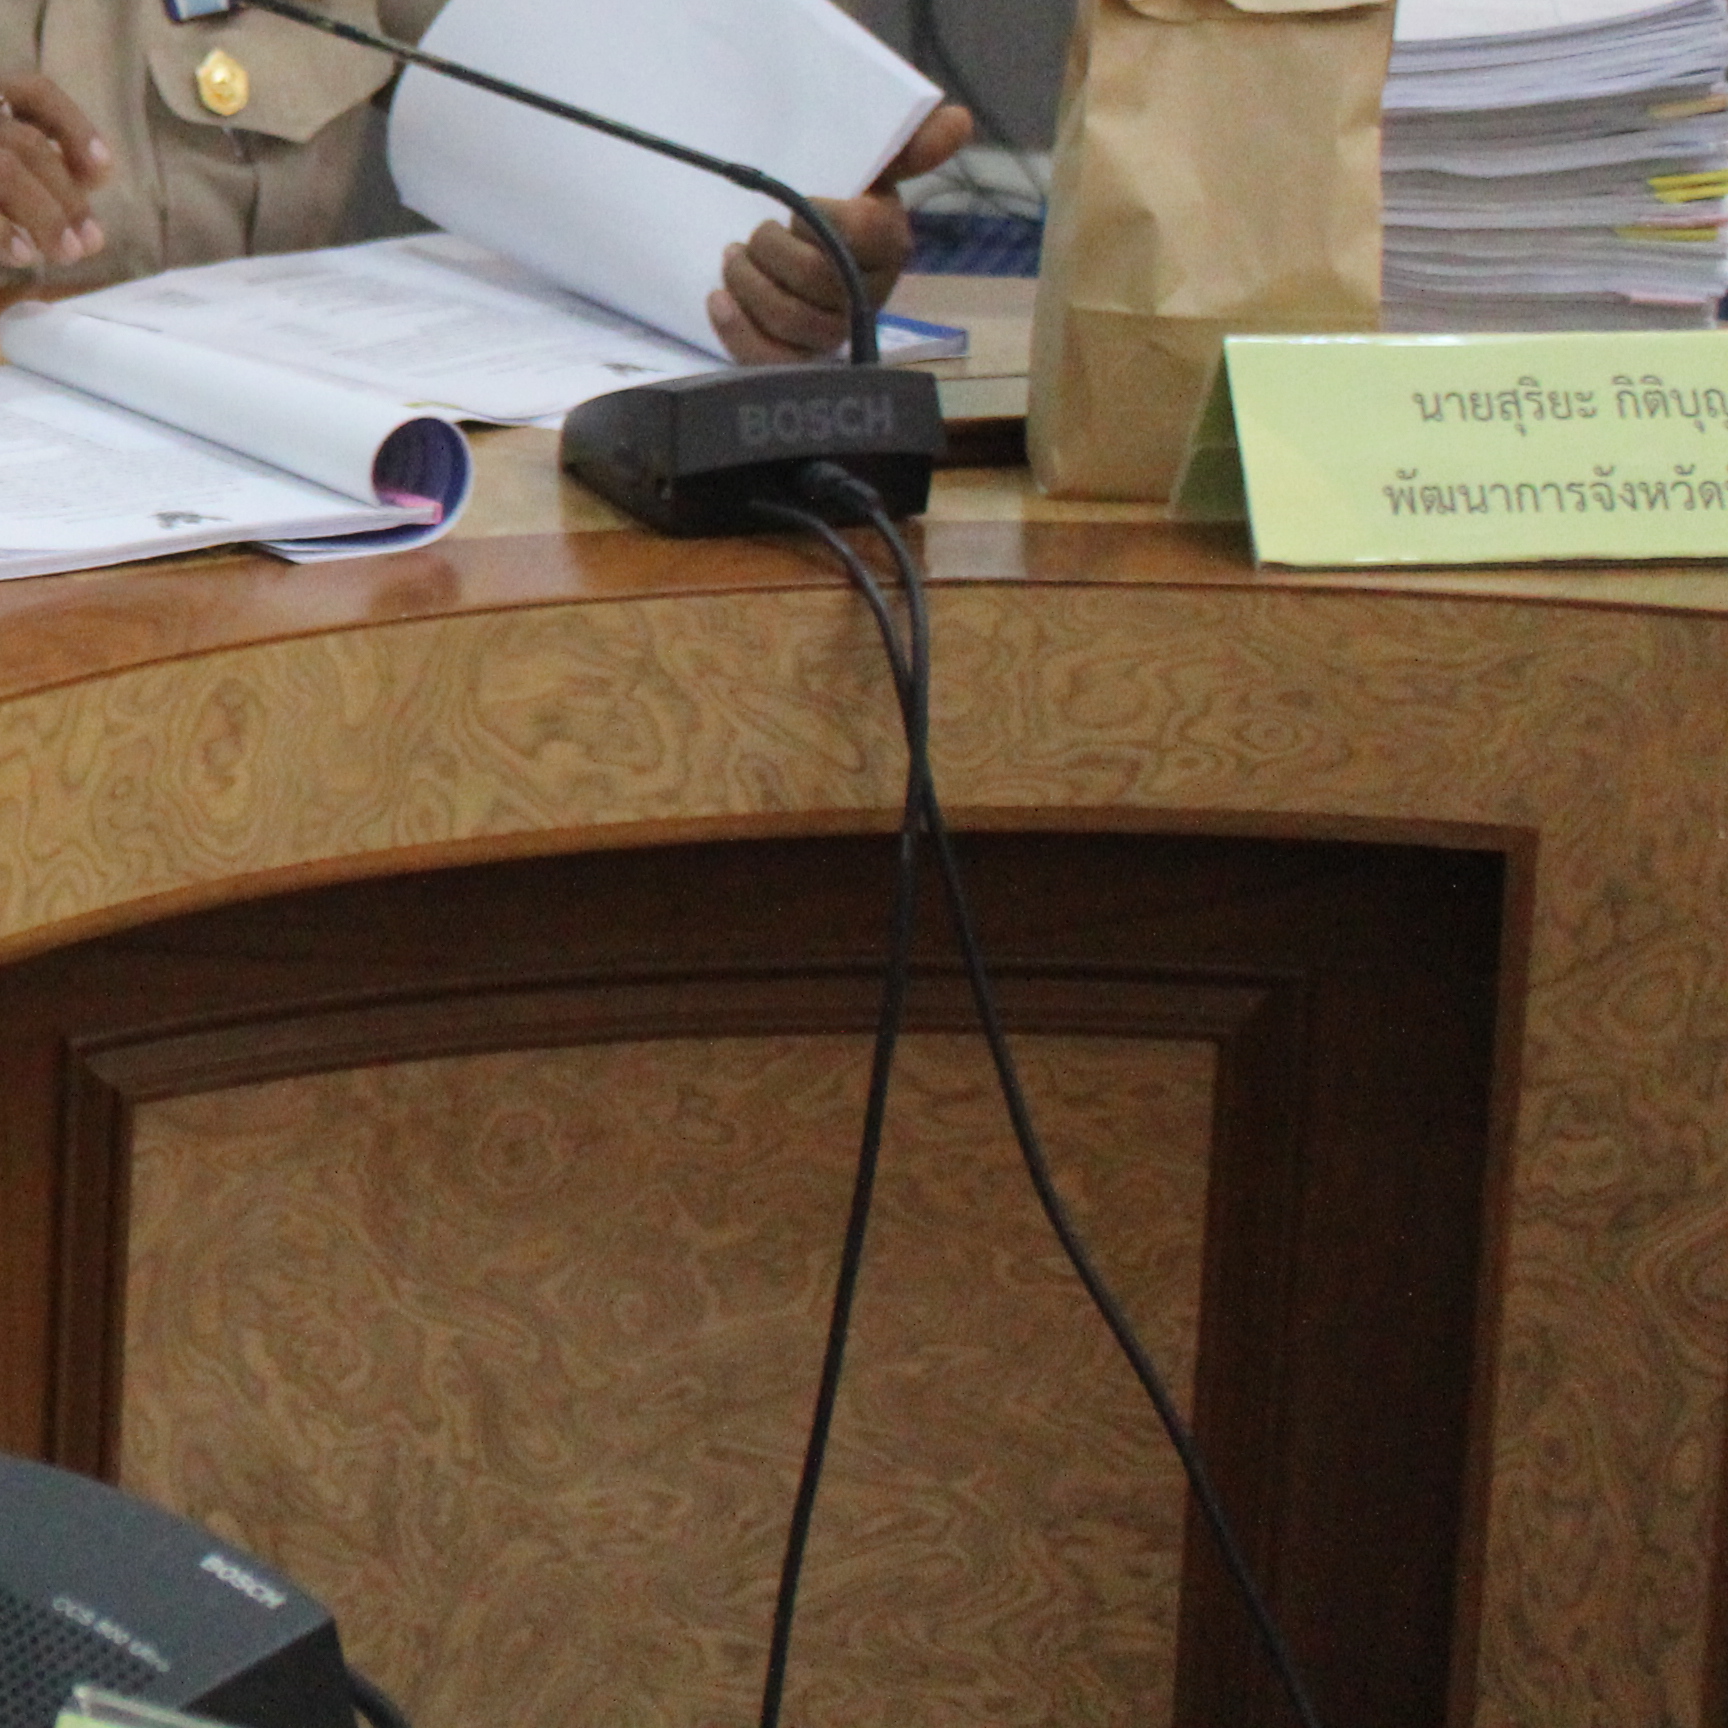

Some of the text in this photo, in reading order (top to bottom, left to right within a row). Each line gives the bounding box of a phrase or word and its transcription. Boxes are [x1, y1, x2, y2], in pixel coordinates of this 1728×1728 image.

[738, 394, 894, 446] BOSCH
[1413, 375, 1598, 436] นายสุริยะ
[1382, 463, 1728, 516] พัฒนาการจังหวัด
[200, 1553, 288, 1610] BOSCH
